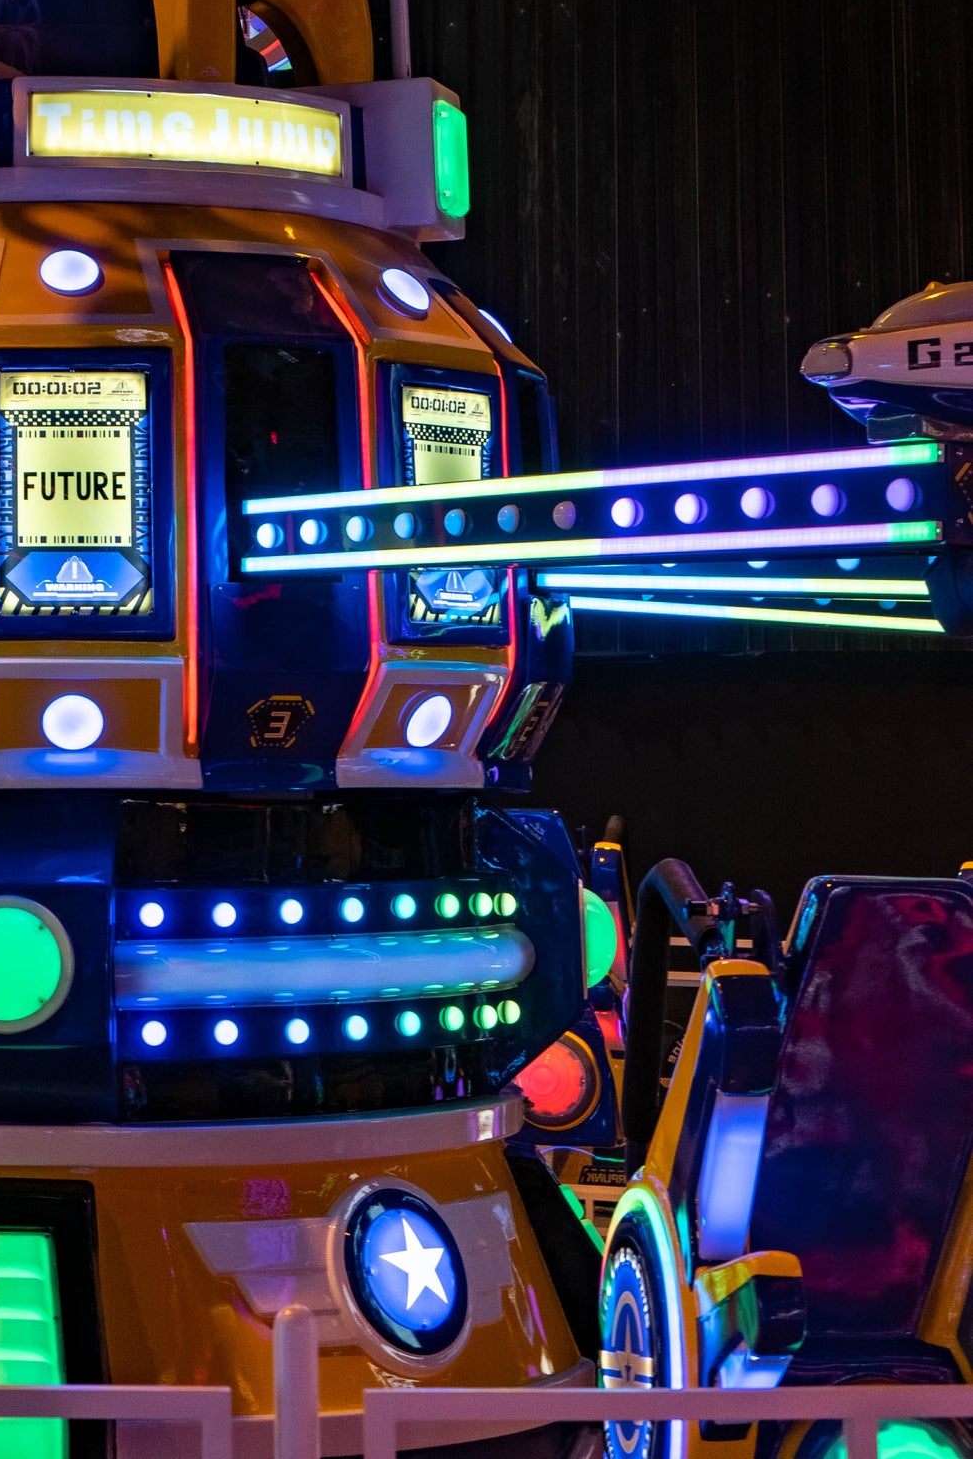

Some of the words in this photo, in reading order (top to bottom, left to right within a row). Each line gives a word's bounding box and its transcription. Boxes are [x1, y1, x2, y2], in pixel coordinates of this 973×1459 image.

[37, 103, 195, 146] Time
[209, 108, 336, 164] Jump
[12, 381, 102, 395] 00:01:02
[411, 396, 466, 415] 00:01:02
[23, 472, 126, 500] FUTURE
[45, 583, 105, 592] WARNING
[264, 711, 291, 739] 3
